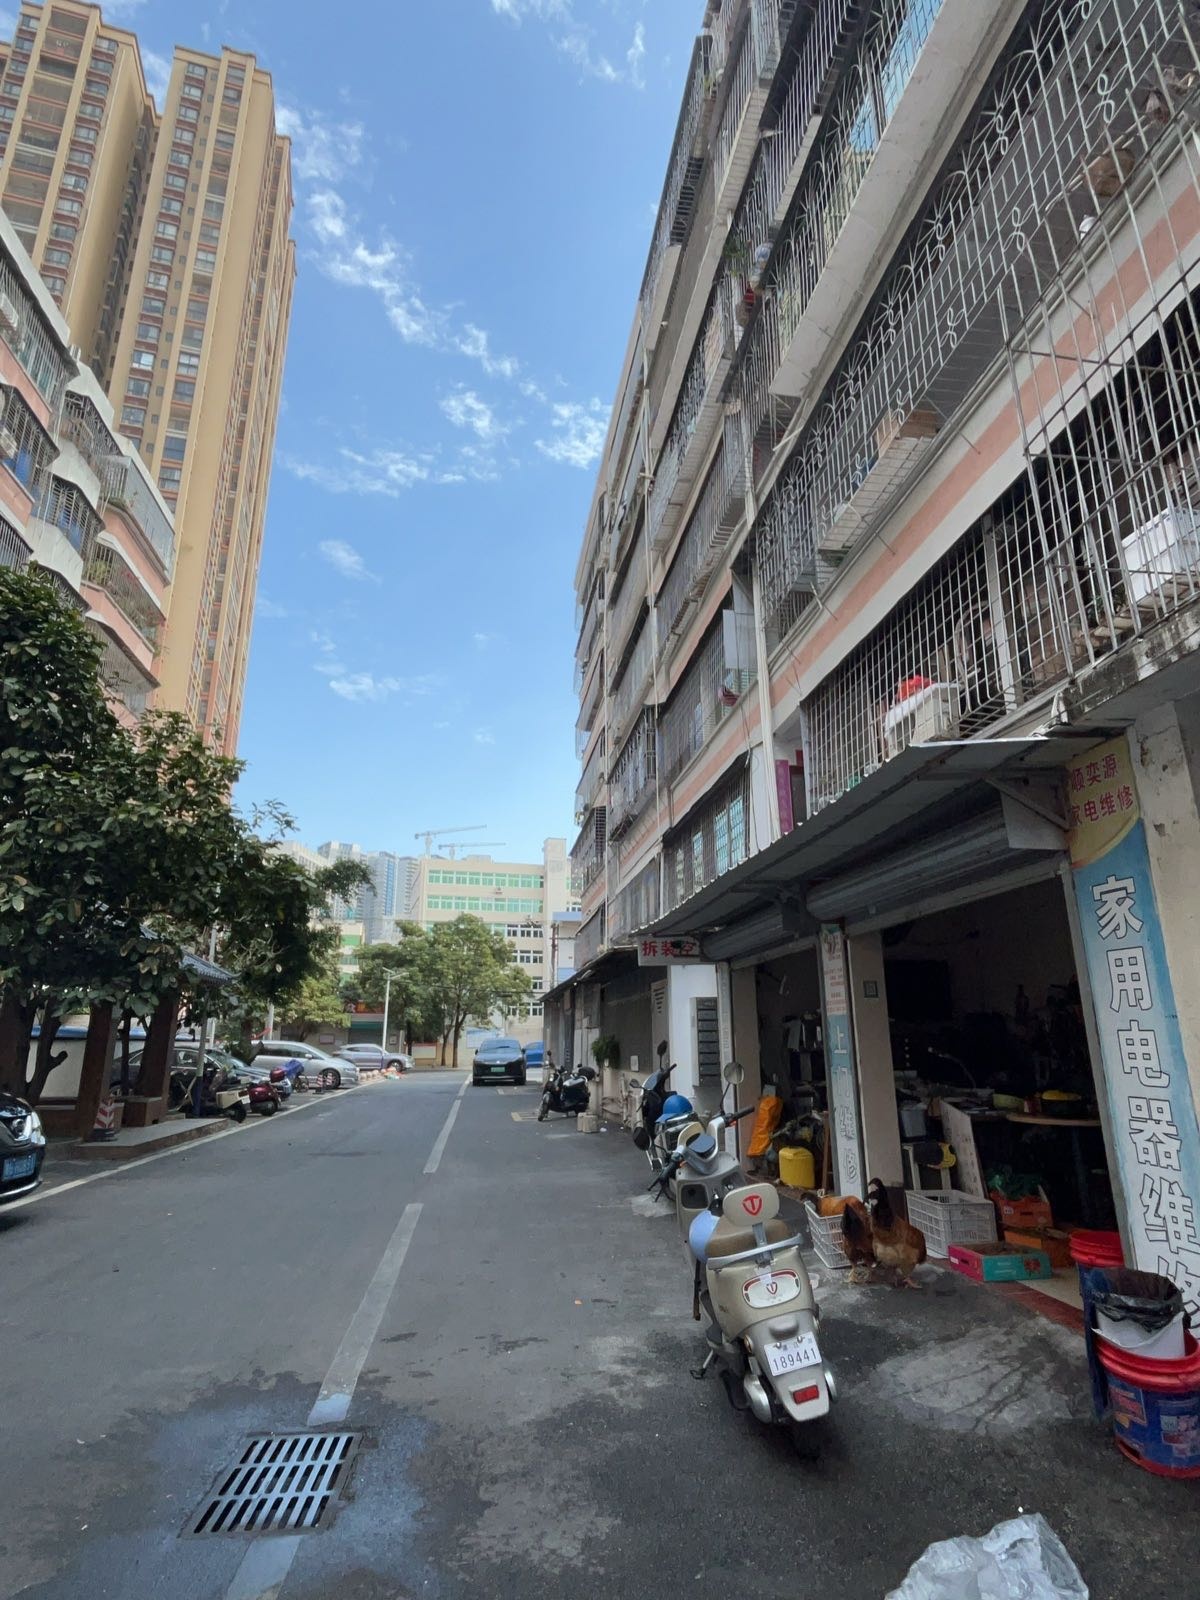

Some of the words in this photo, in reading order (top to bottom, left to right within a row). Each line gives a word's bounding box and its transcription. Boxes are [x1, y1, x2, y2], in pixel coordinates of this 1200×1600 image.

[1072, 785, 1134, 824] 家电维修
[773, 1347, 816, 1371] 189441
